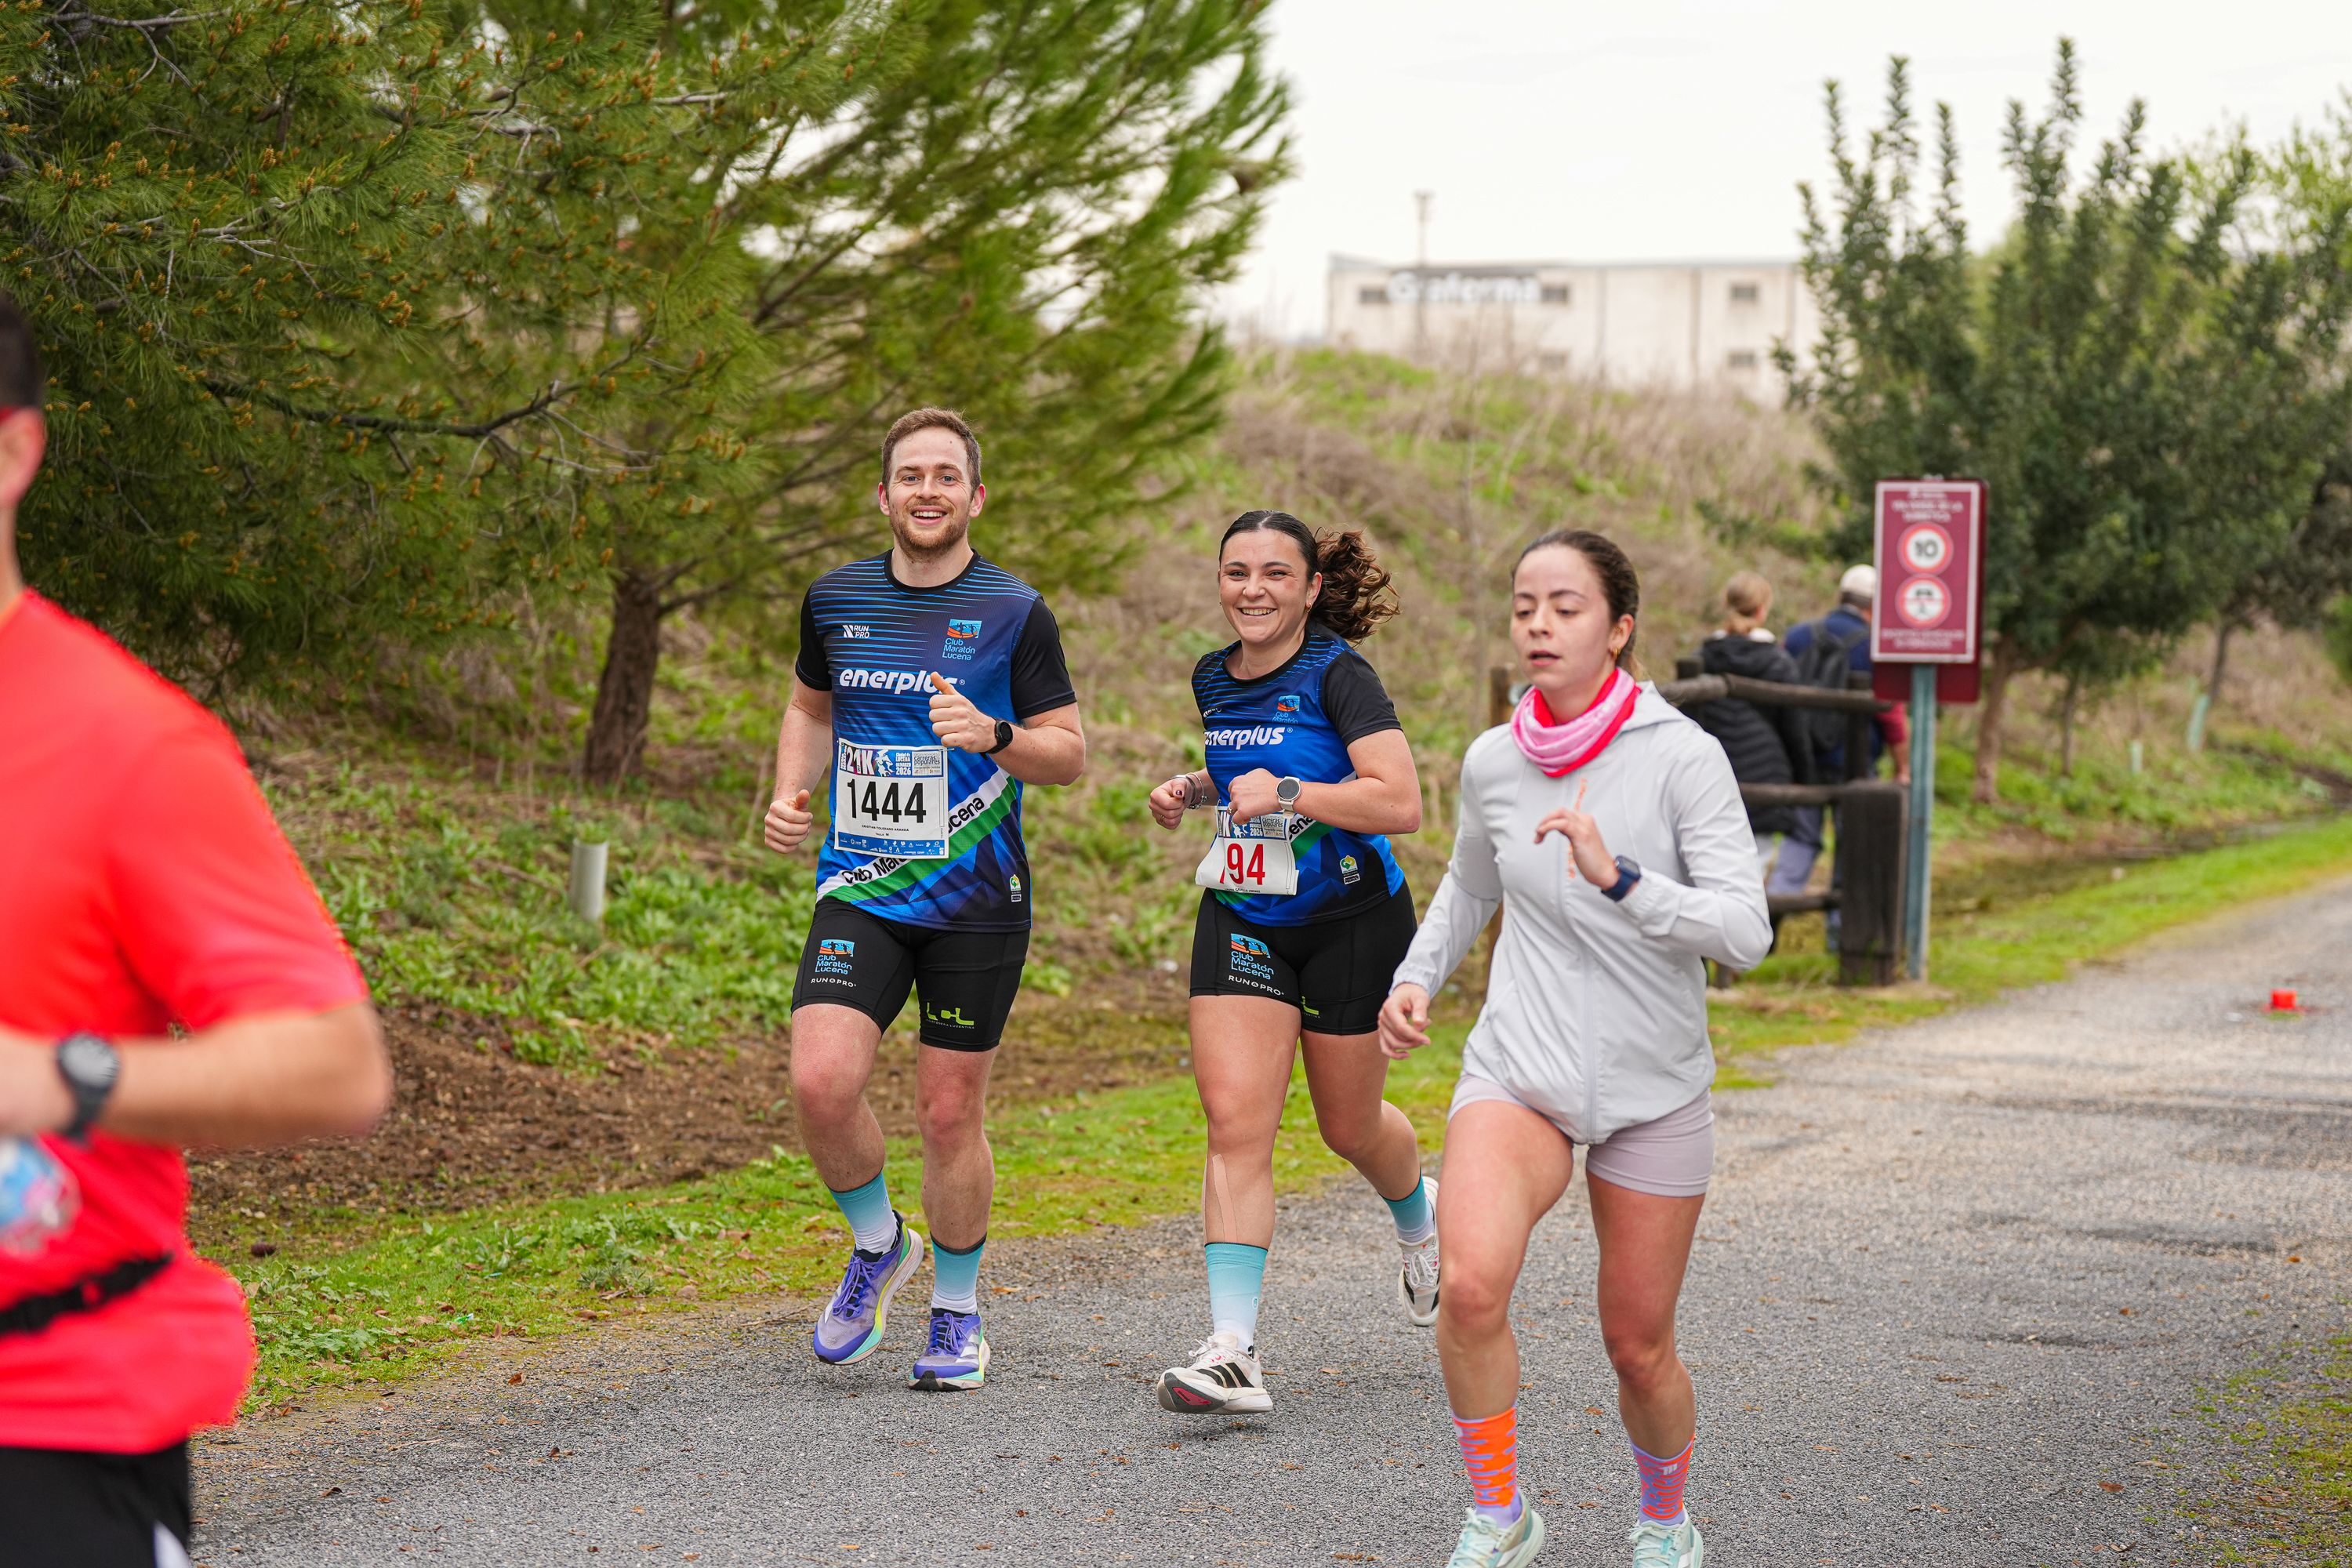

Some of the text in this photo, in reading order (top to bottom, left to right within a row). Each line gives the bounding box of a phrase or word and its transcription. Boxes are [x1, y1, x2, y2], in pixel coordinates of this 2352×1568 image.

[1915, 539, 1939, 558] 10
[945, 637, 964, 646] Club
[943, 644, 976, 655] Maratón
[942, 651, 972, 661] Lucena
[847, 746, 875, 775] 21K
[895, 767, 912, 775] 2026
[847, 778, 927, 823] 1444
[1231, 950, 1254, 962] Club
[815, 965, 848, 975] Lucena
[816, 960, 852, 971] Maratón
[1231, 956, 1275, 975] Maratón
[1231, 963, 1271, 980] Lucena
